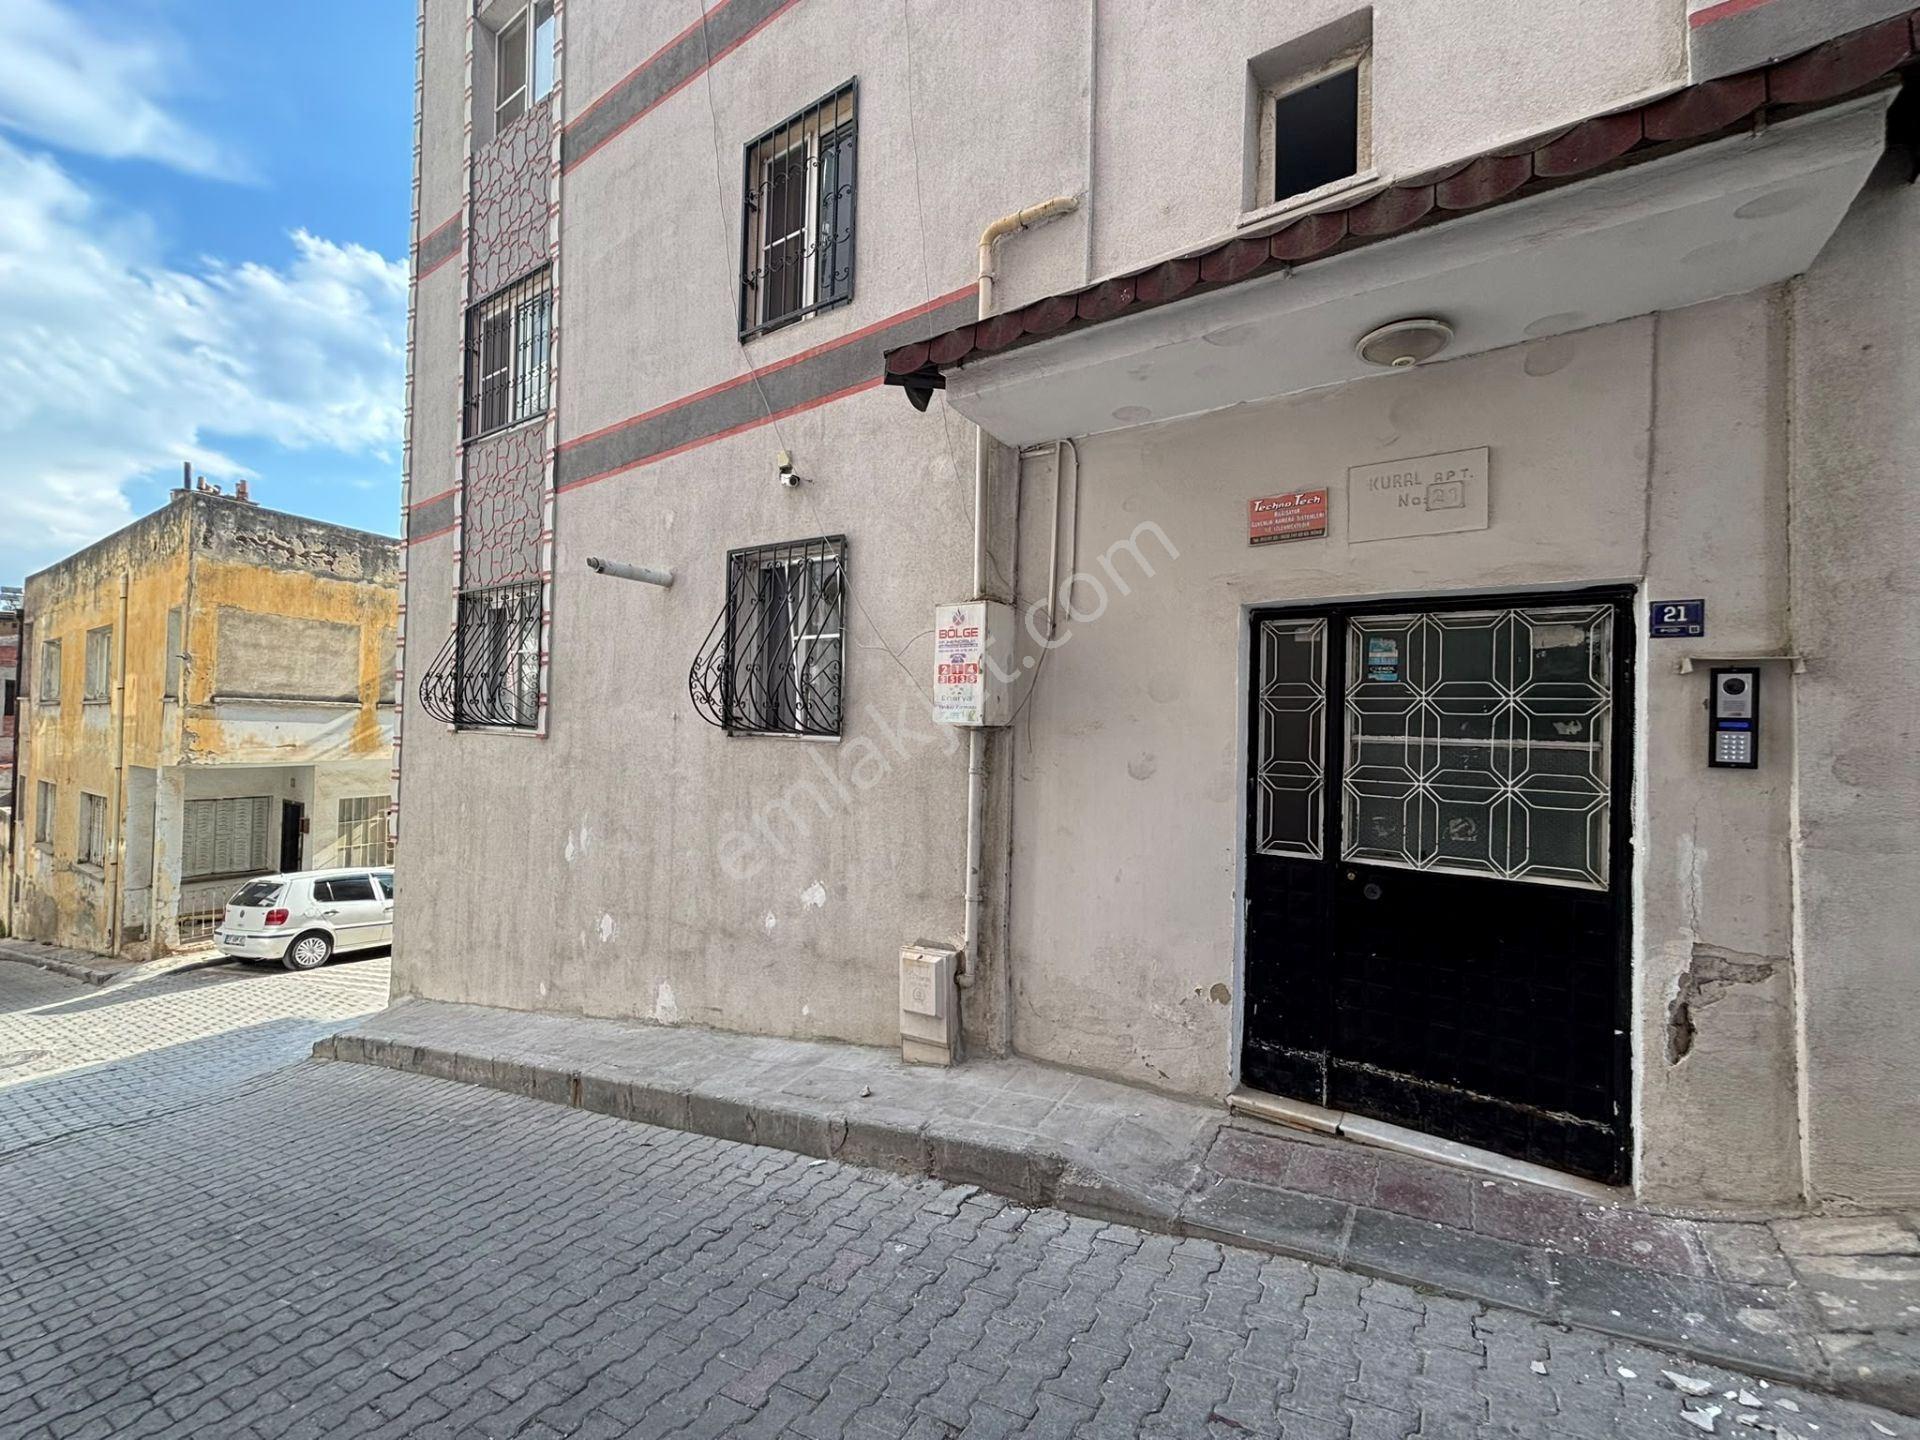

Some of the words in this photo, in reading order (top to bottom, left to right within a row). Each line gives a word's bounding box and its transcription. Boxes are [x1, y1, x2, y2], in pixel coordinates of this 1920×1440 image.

[1369, 471, 1422, 491] KURAL
[1663, 605, 1688, 623] 21
[938, 626, 979, 639] BÖLGE
